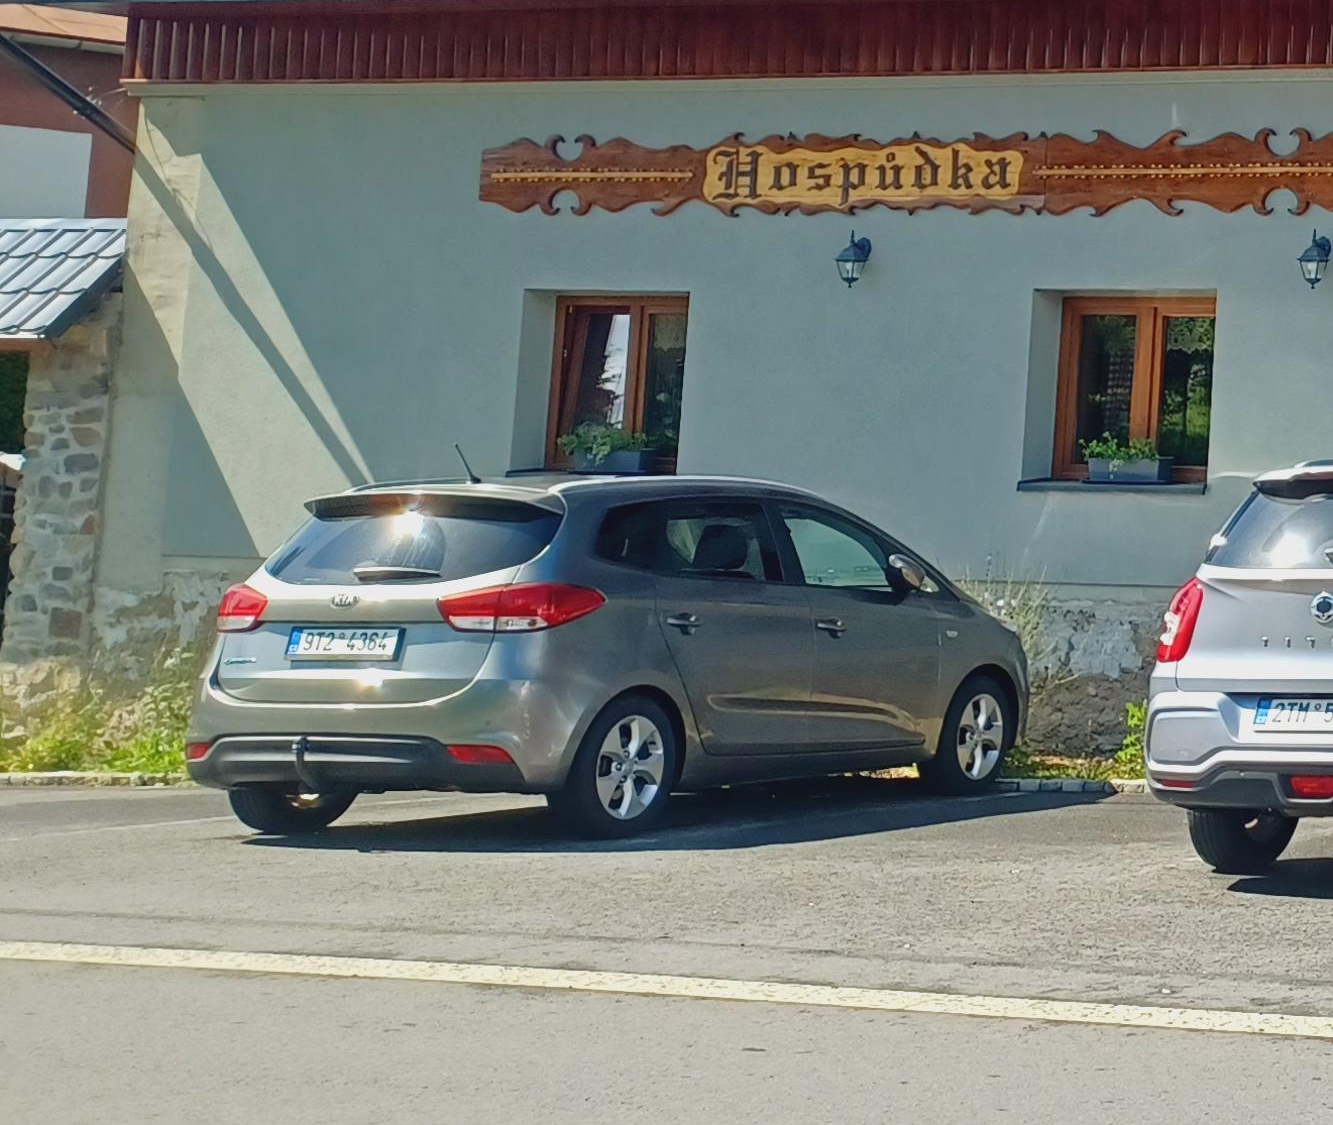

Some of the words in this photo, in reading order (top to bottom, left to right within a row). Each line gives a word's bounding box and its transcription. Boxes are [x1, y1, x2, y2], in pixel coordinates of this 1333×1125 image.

[712, 145, 1011, 205] Hospůdka
[303, 632, 335, 651] 9T2
[346, 632, 388, 651] 4364
[1272, 702, 1310, 723] 2TM
